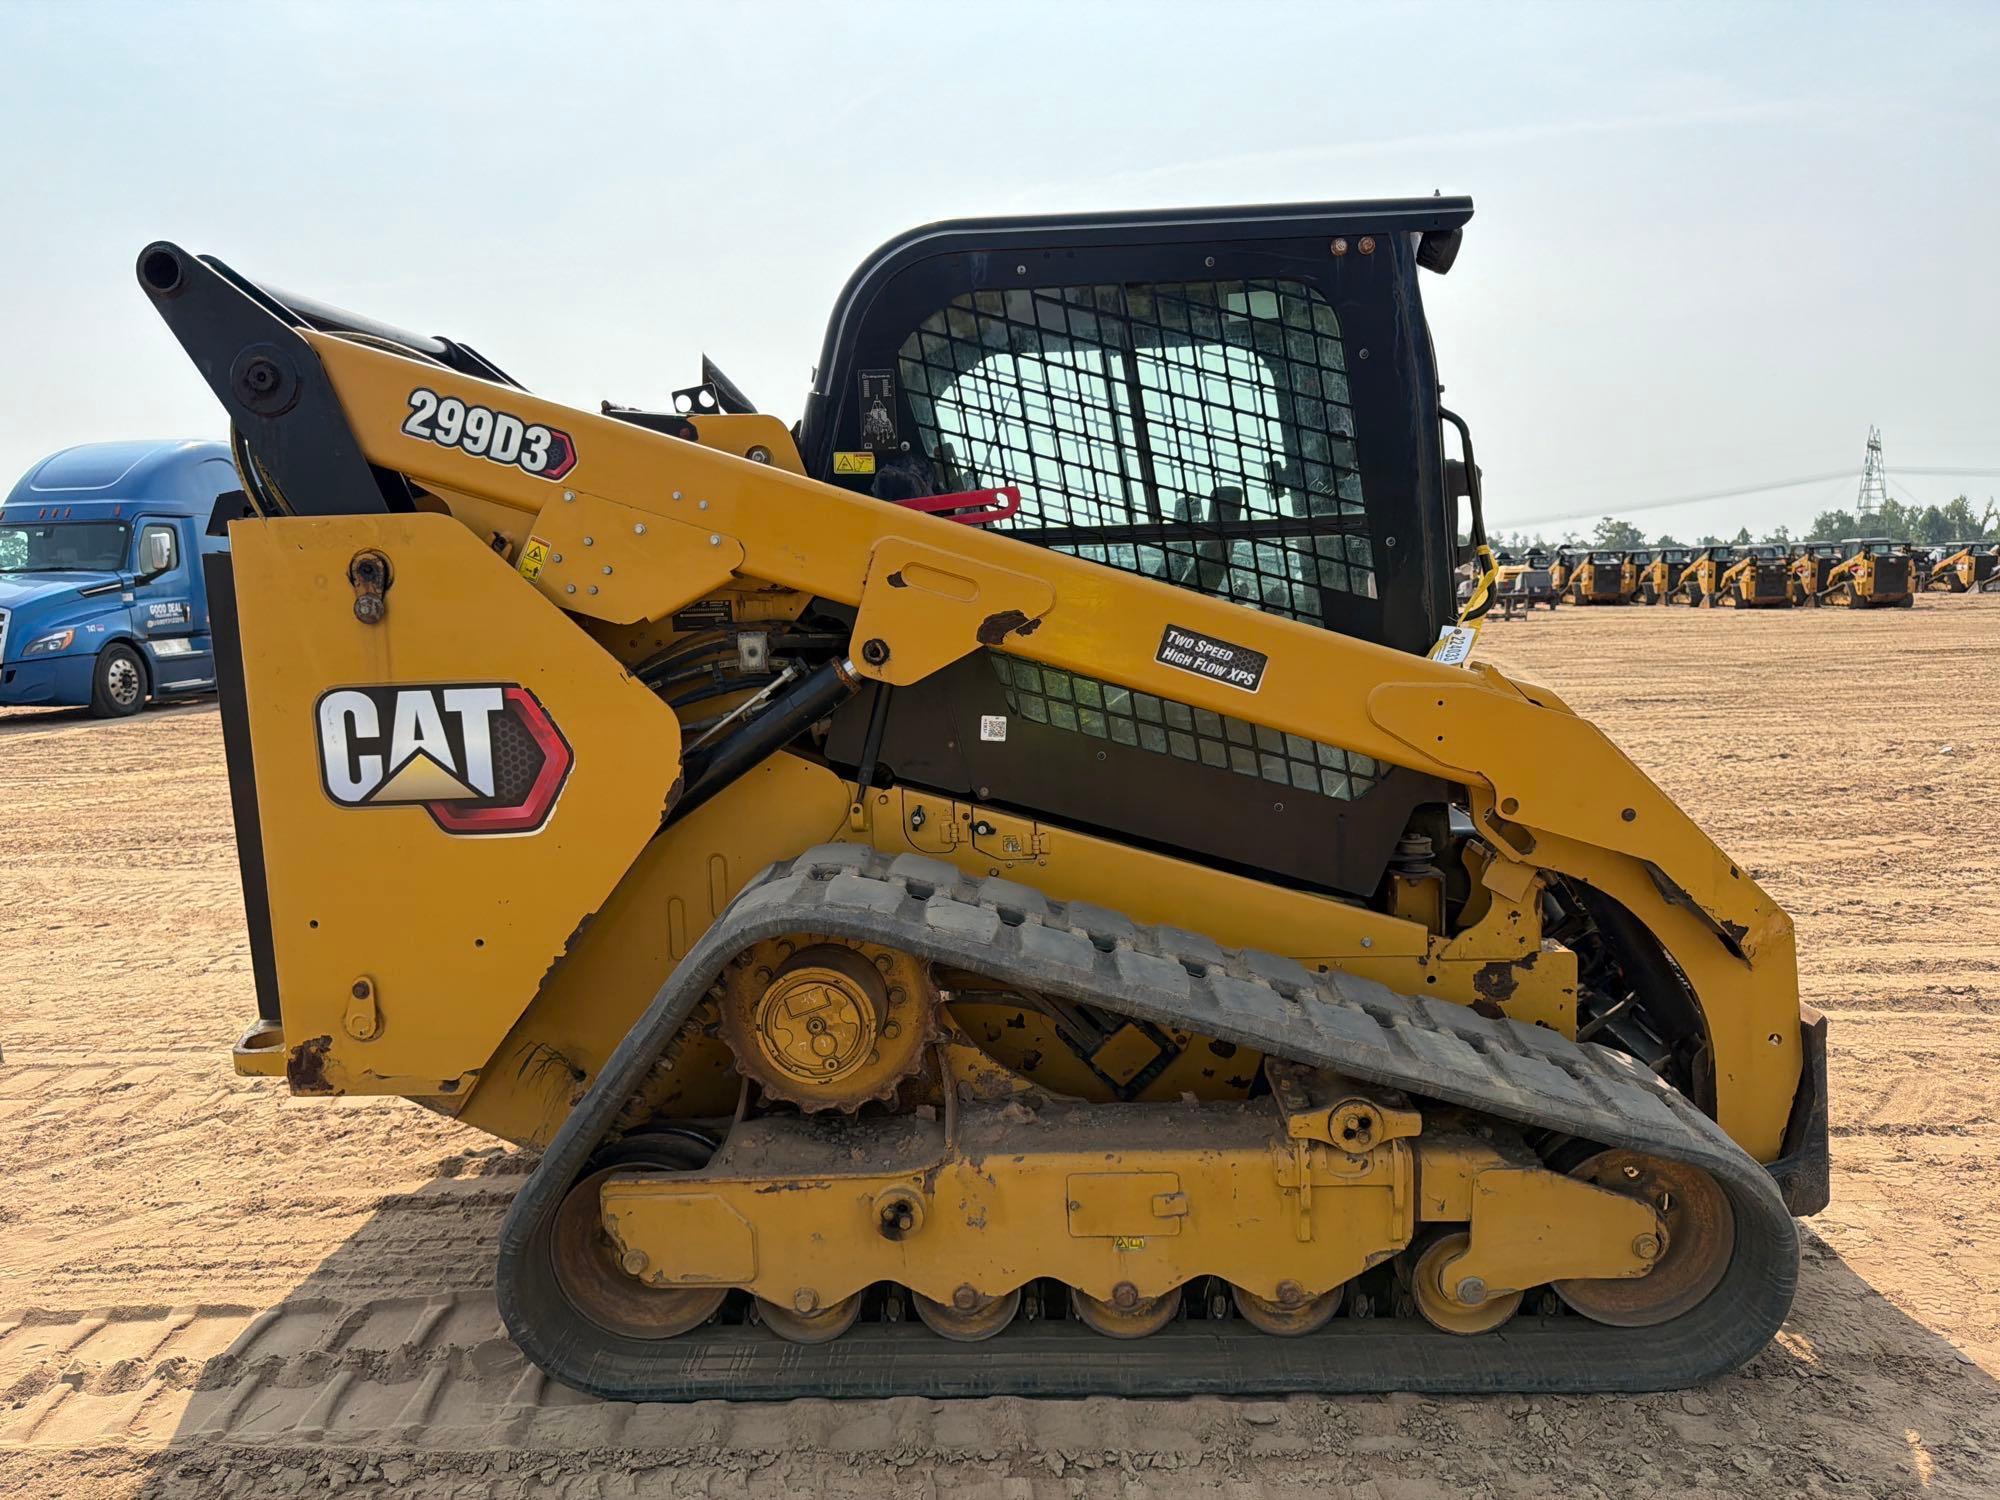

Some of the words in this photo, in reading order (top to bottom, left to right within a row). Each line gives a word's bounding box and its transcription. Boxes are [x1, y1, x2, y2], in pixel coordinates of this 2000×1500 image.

[405, 389, 552, 472] 299D3
[149, 604, 167, 615] GOOD
[1166, 630, 1195, 649] TWO
[1195, 639, 1234, 662] SPEED
[1161, 647, 1193, 666] HIGH
[1193, 657, 1228, 678] FLOW
[1227, 667, 1256, 686] XPS
[319, 687, 504, 802] CAT
